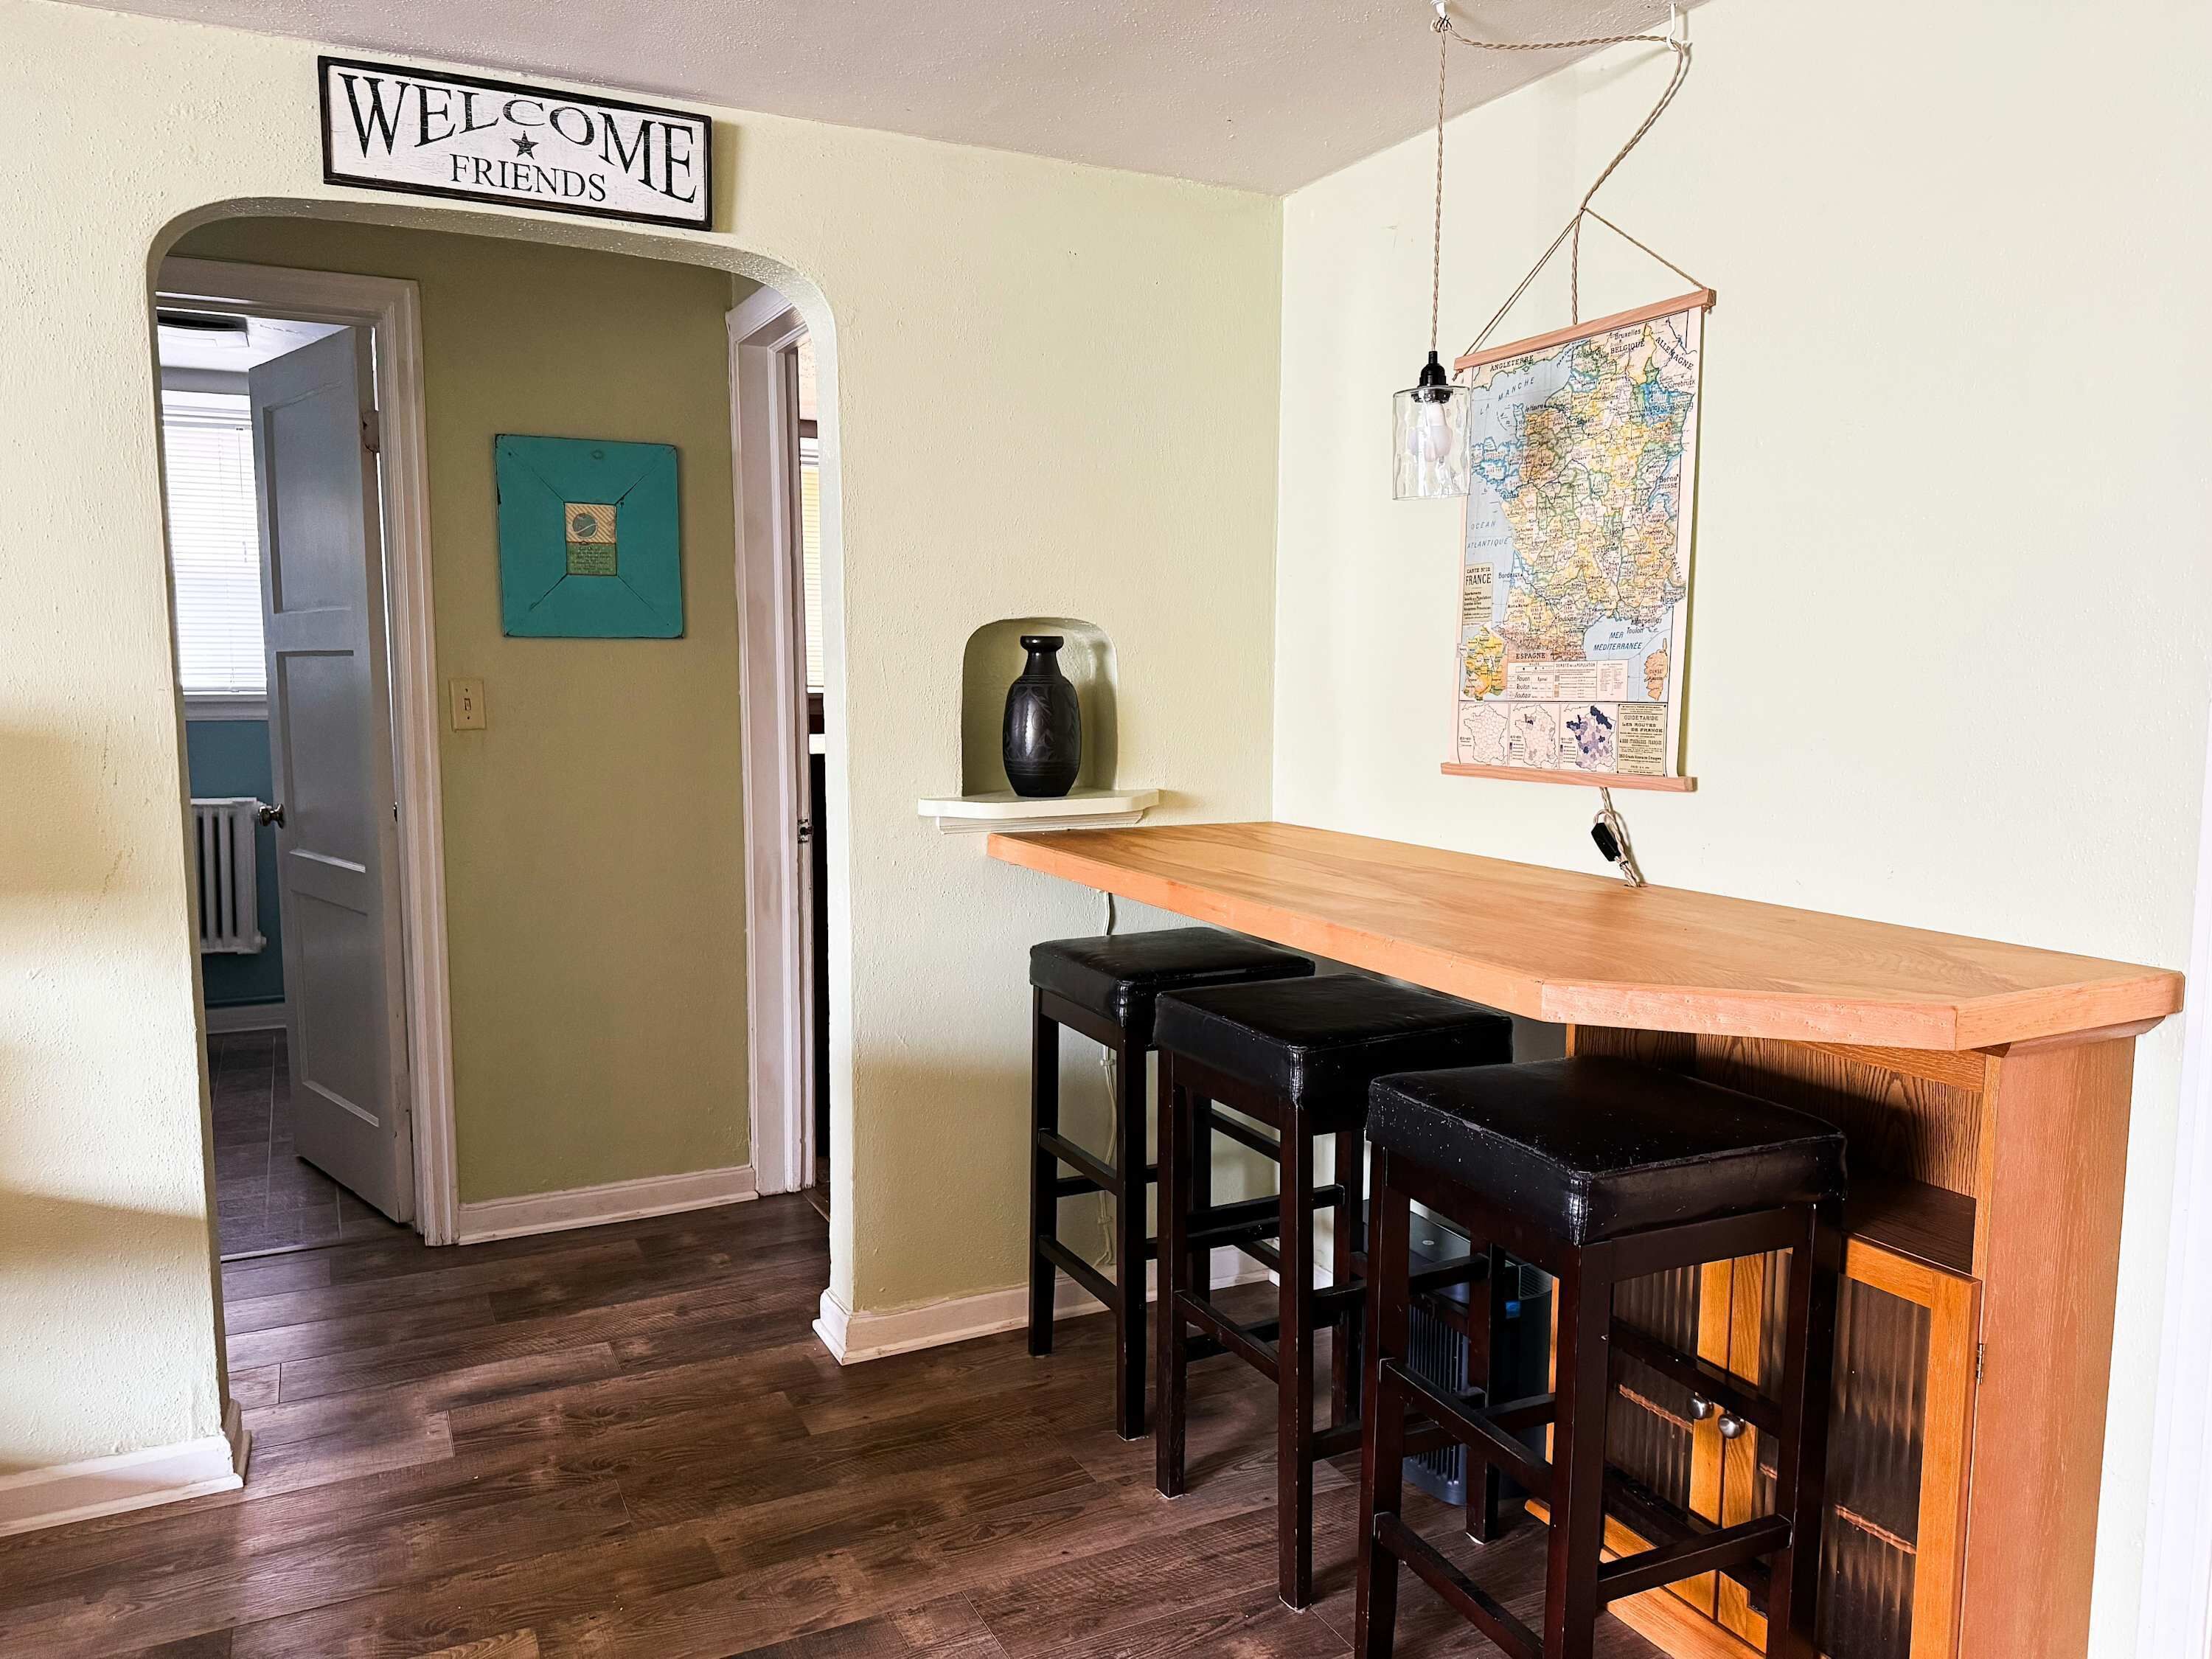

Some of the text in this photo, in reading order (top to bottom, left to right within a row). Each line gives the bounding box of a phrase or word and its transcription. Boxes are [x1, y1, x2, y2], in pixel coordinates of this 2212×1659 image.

[338, 72, 698, 204] WELCOME
[450, 153, 607, 202] FRIENDS
[1615, 329, 1641, 340] Bruxelles
[1610, 341, 1645, 354] BELGIQUE
[1655, 336, 1694, 371] ALLEMAGNE
[1489, 355, 1534, 372] ANGLETERRE
[1467, 538, 1509, 549] ATLANTIQUE
[1465, 573, 1492, 587] FRANCE
